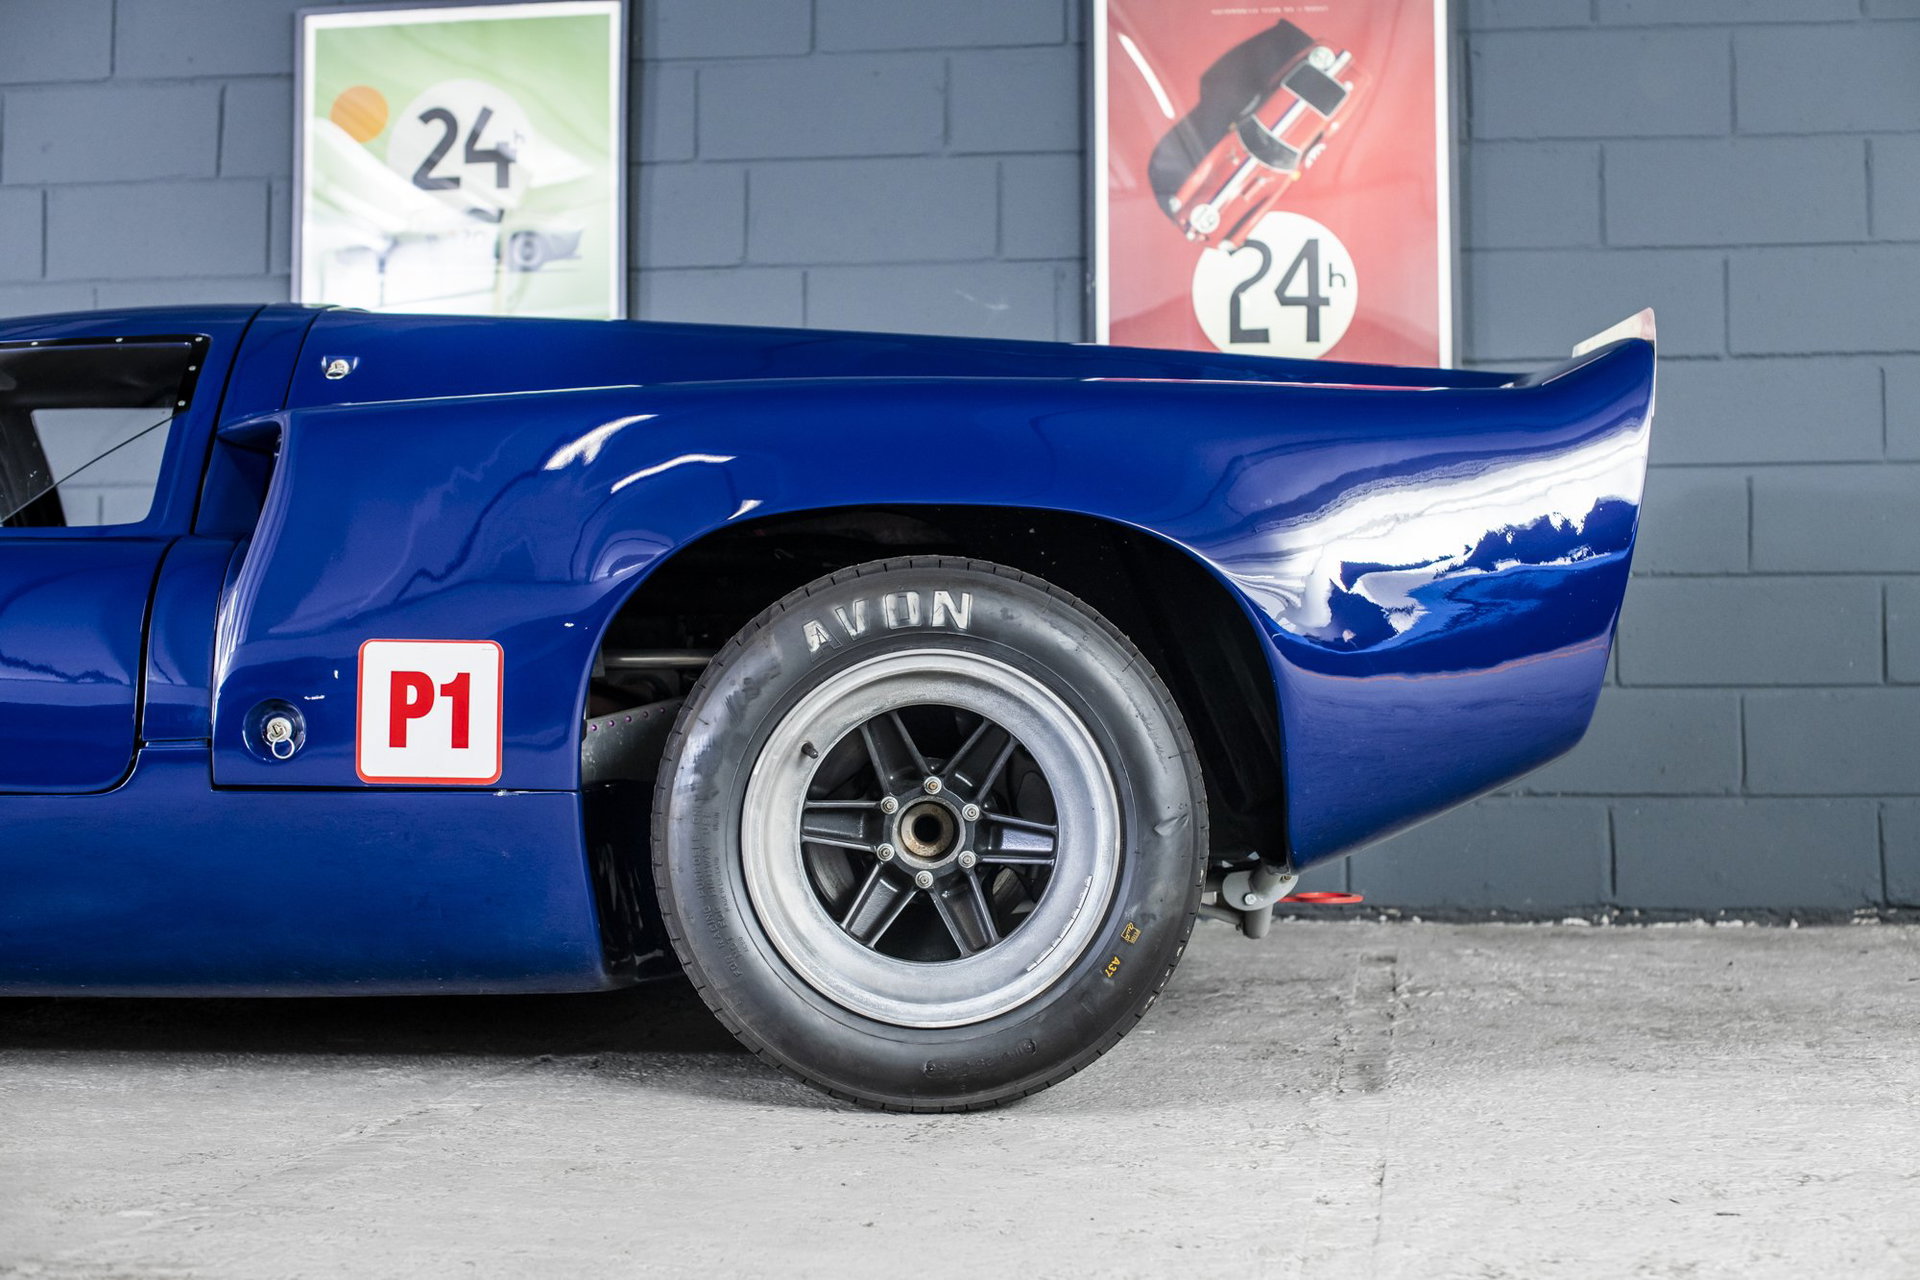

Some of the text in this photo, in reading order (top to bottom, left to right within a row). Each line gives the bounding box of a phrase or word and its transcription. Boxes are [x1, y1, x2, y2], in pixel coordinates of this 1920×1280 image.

[803, 590, 972, 662] AVON
[389, 671, 470, 749] P1
[1105, 956, 1120, 977] A37
